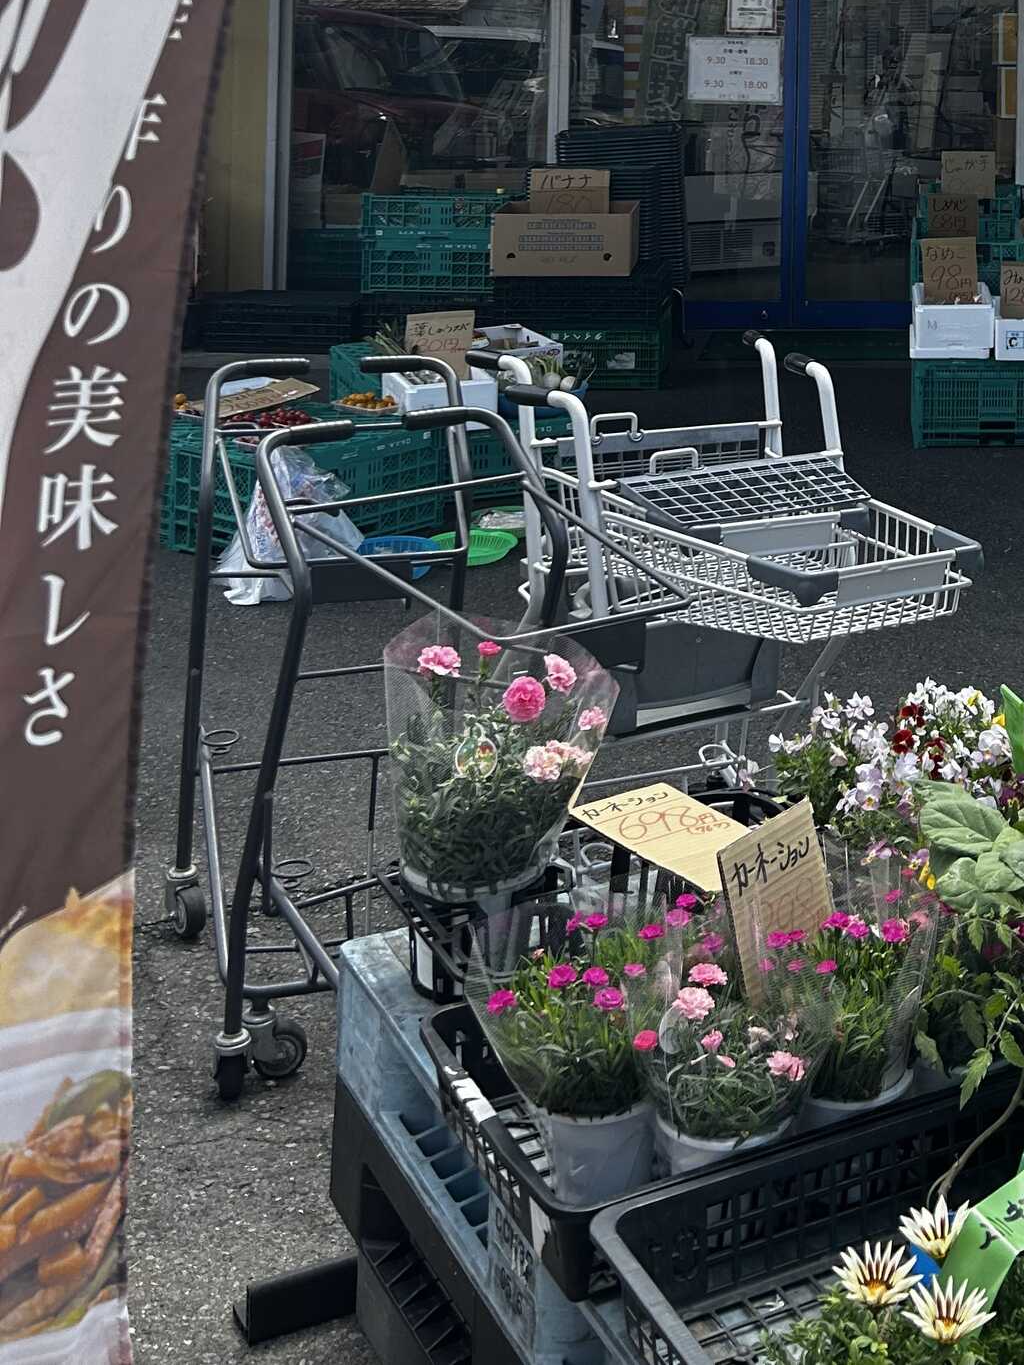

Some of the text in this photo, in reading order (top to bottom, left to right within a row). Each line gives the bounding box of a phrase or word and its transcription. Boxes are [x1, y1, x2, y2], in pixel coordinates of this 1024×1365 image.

[541, 173, 593, 189] バナナ
[926, 245, 968, 261] なめこ
[581, 790, 669, 821] カーネーション
[618, 805, 717, 841] 698円
[732, 836, 811, 896] カーネーション
